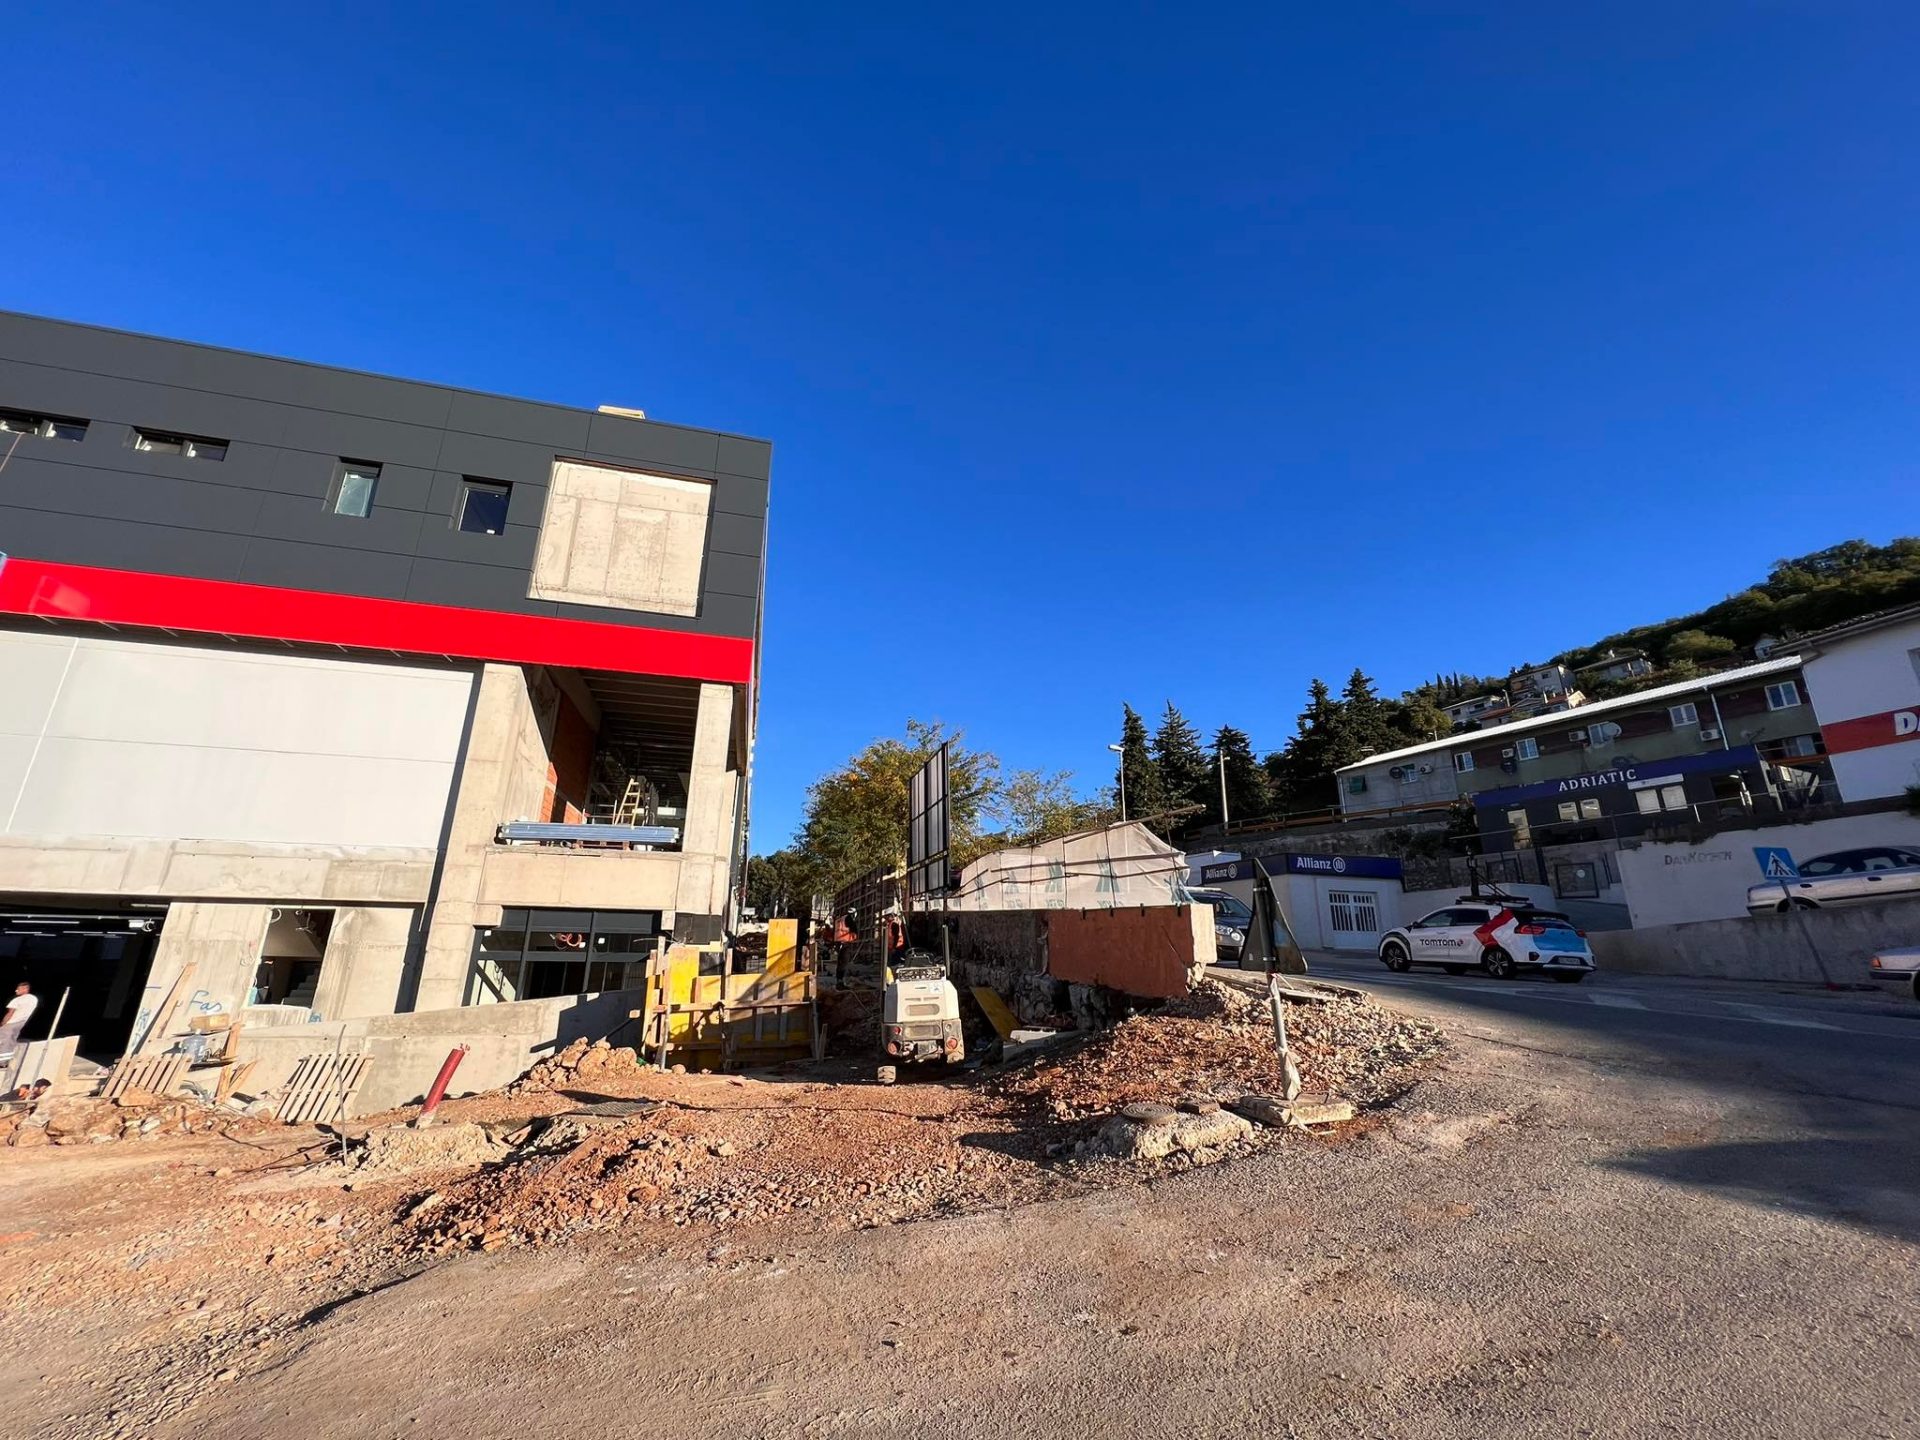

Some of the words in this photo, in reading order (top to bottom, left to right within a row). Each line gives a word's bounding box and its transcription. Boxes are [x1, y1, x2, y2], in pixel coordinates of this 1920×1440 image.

[1559, 769, 1636, 791] ADRIATIC
[1296, 857, 1332, 870] Allianz
[1205, 868, 1228, 879] Allianz
